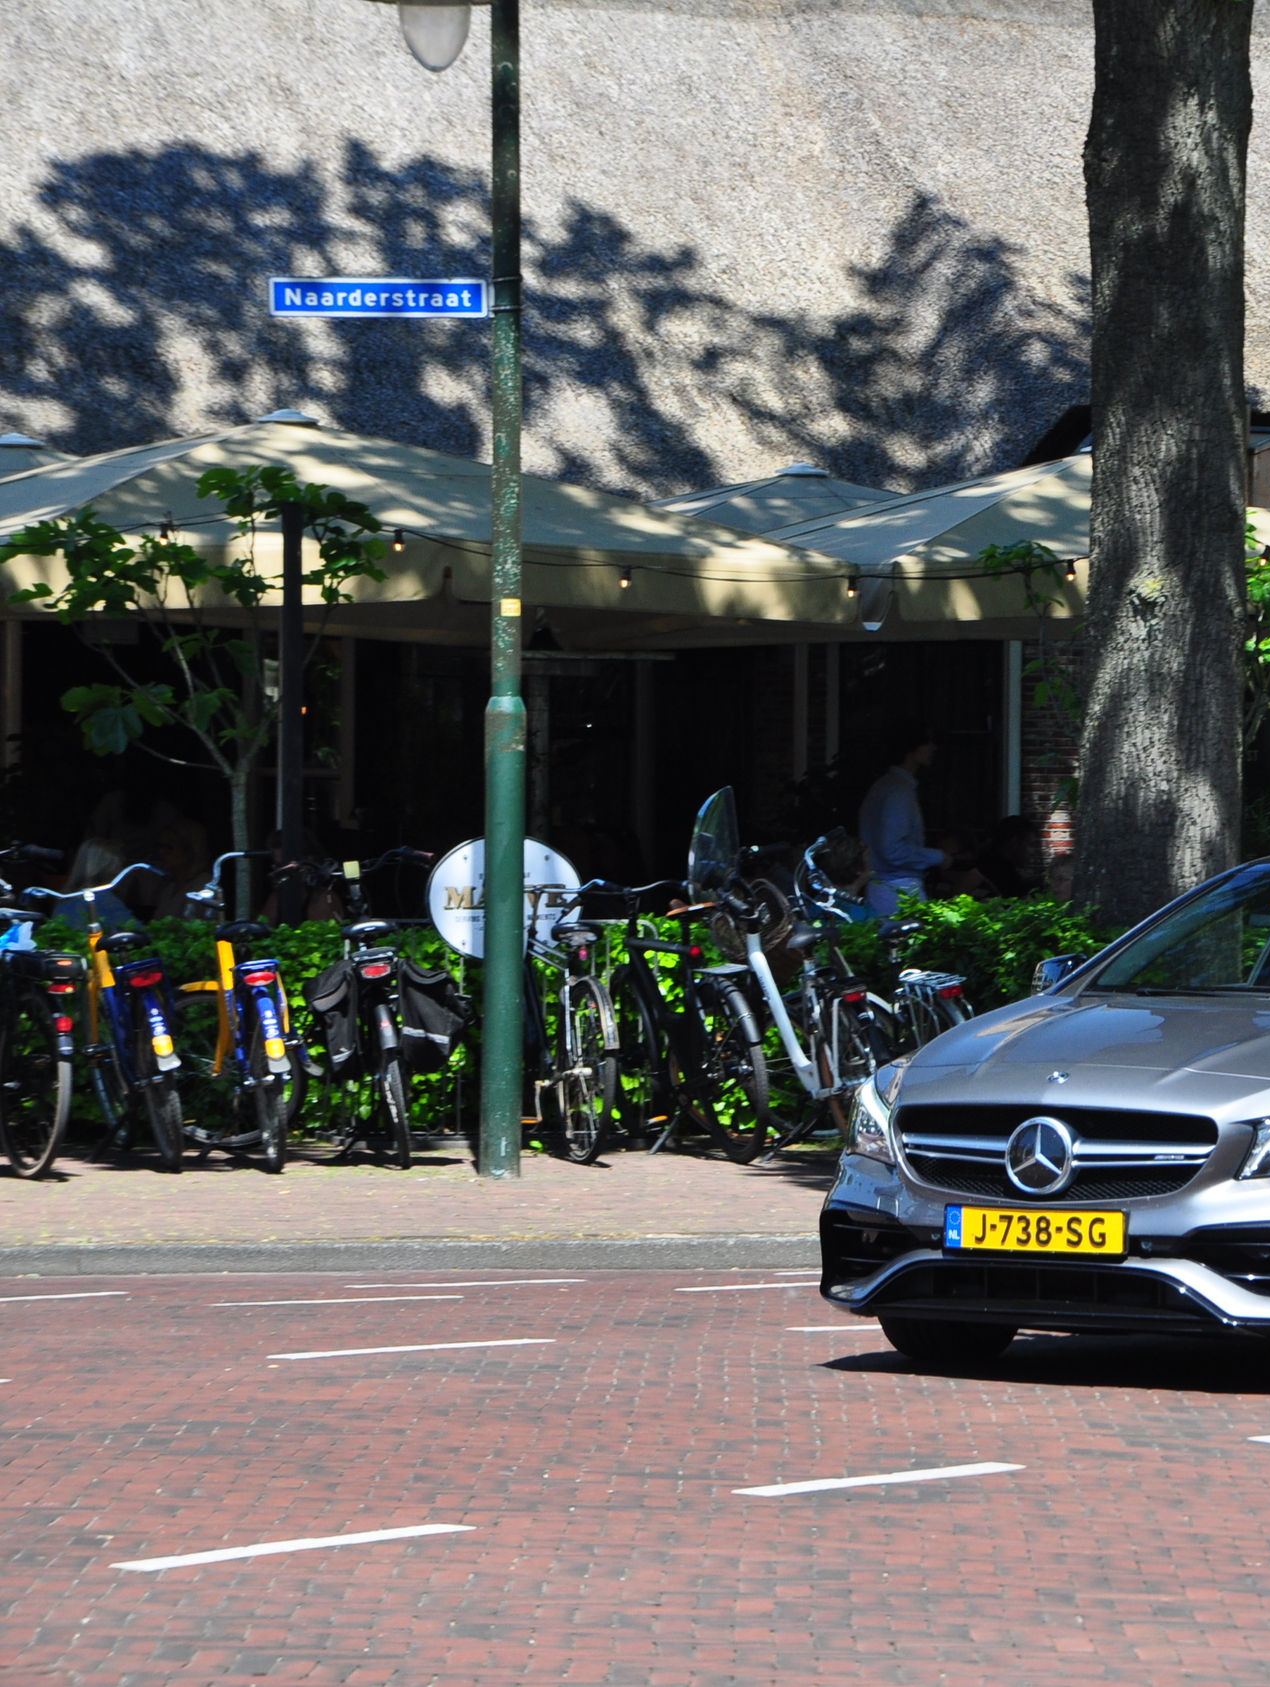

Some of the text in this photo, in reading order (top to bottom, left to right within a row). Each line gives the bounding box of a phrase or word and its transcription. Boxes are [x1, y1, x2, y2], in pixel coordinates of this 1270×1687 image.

[284, 287, 472, 308] Naarderstraat
[948, 1229, 961, 1241] NL
[974, 1213, 1107, 1249] J-738-SG
